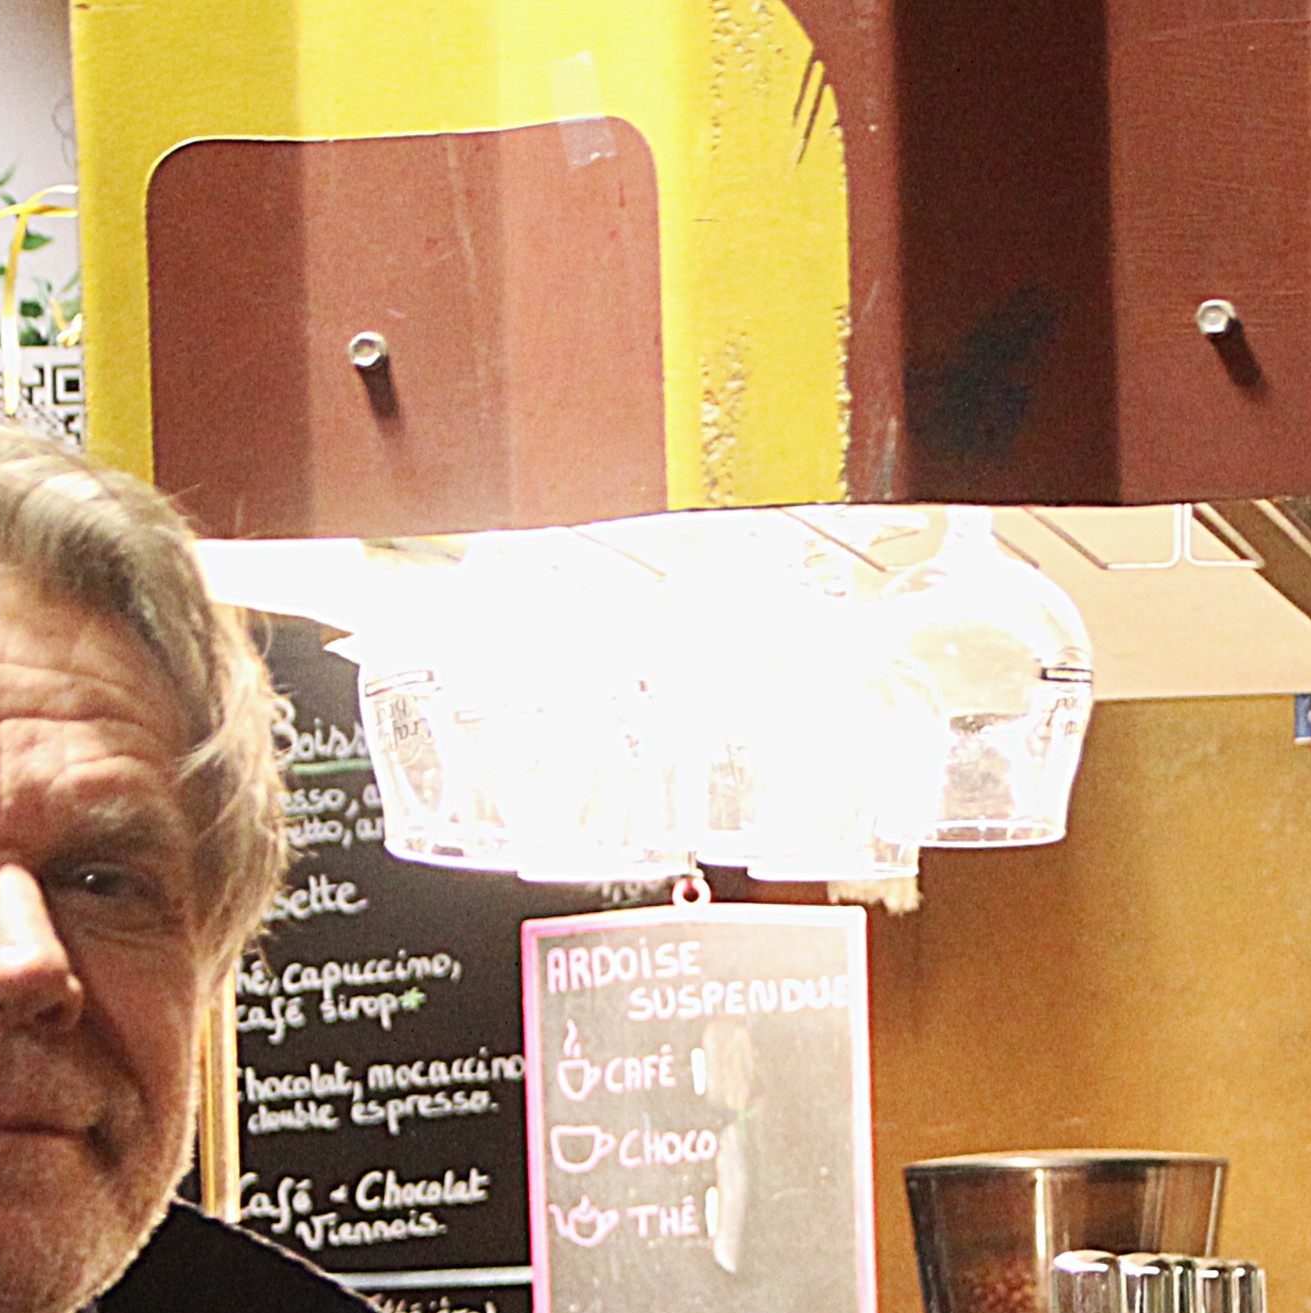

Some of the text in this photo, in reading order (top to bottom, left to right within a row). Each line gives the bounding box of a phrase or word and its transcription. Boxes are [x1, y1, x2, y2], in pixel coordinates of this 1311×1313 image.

[262, 873, 369, 922] sette
[604, 1043, 676, 1094] CAFÉ
[247, 1100, 340, 1135] double
[618, 1127, 718, 1169] CHOCO
[354, 1167, 490, 1211] Chocolat
